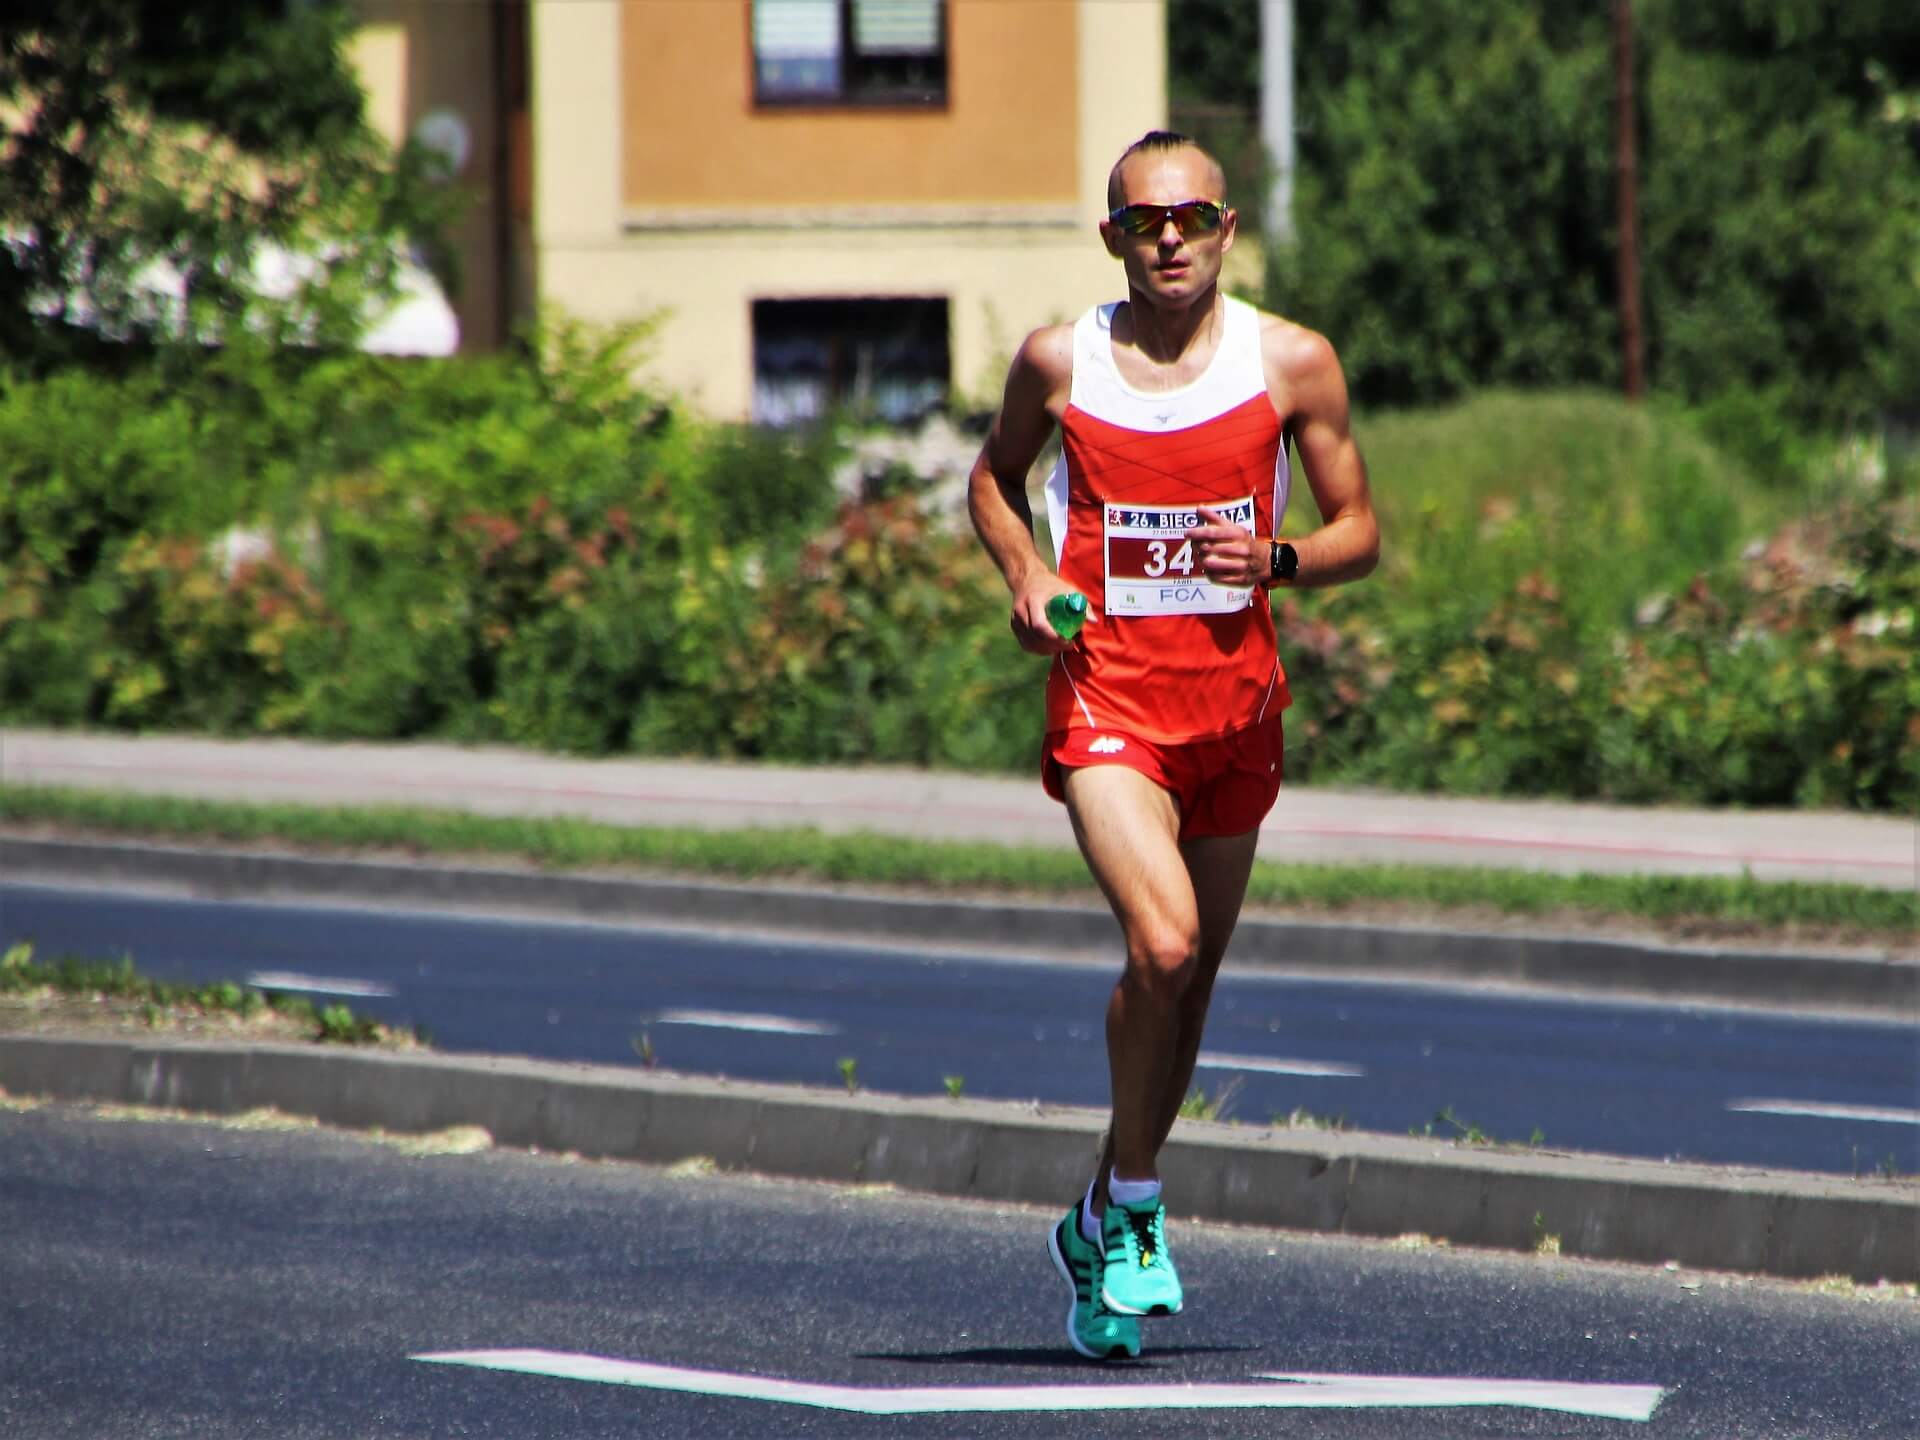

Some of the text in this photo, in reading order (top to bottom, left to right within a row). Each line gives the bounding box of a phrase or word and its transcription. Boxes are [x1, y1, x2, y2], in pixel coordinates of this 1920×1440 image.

[1130, 512, 1154, 528] 26.
[1159, 513, 1199, 529] BIEG
[1143, 540, 1194, 577] 34
[1160, 587, 1206, 602] FCA
